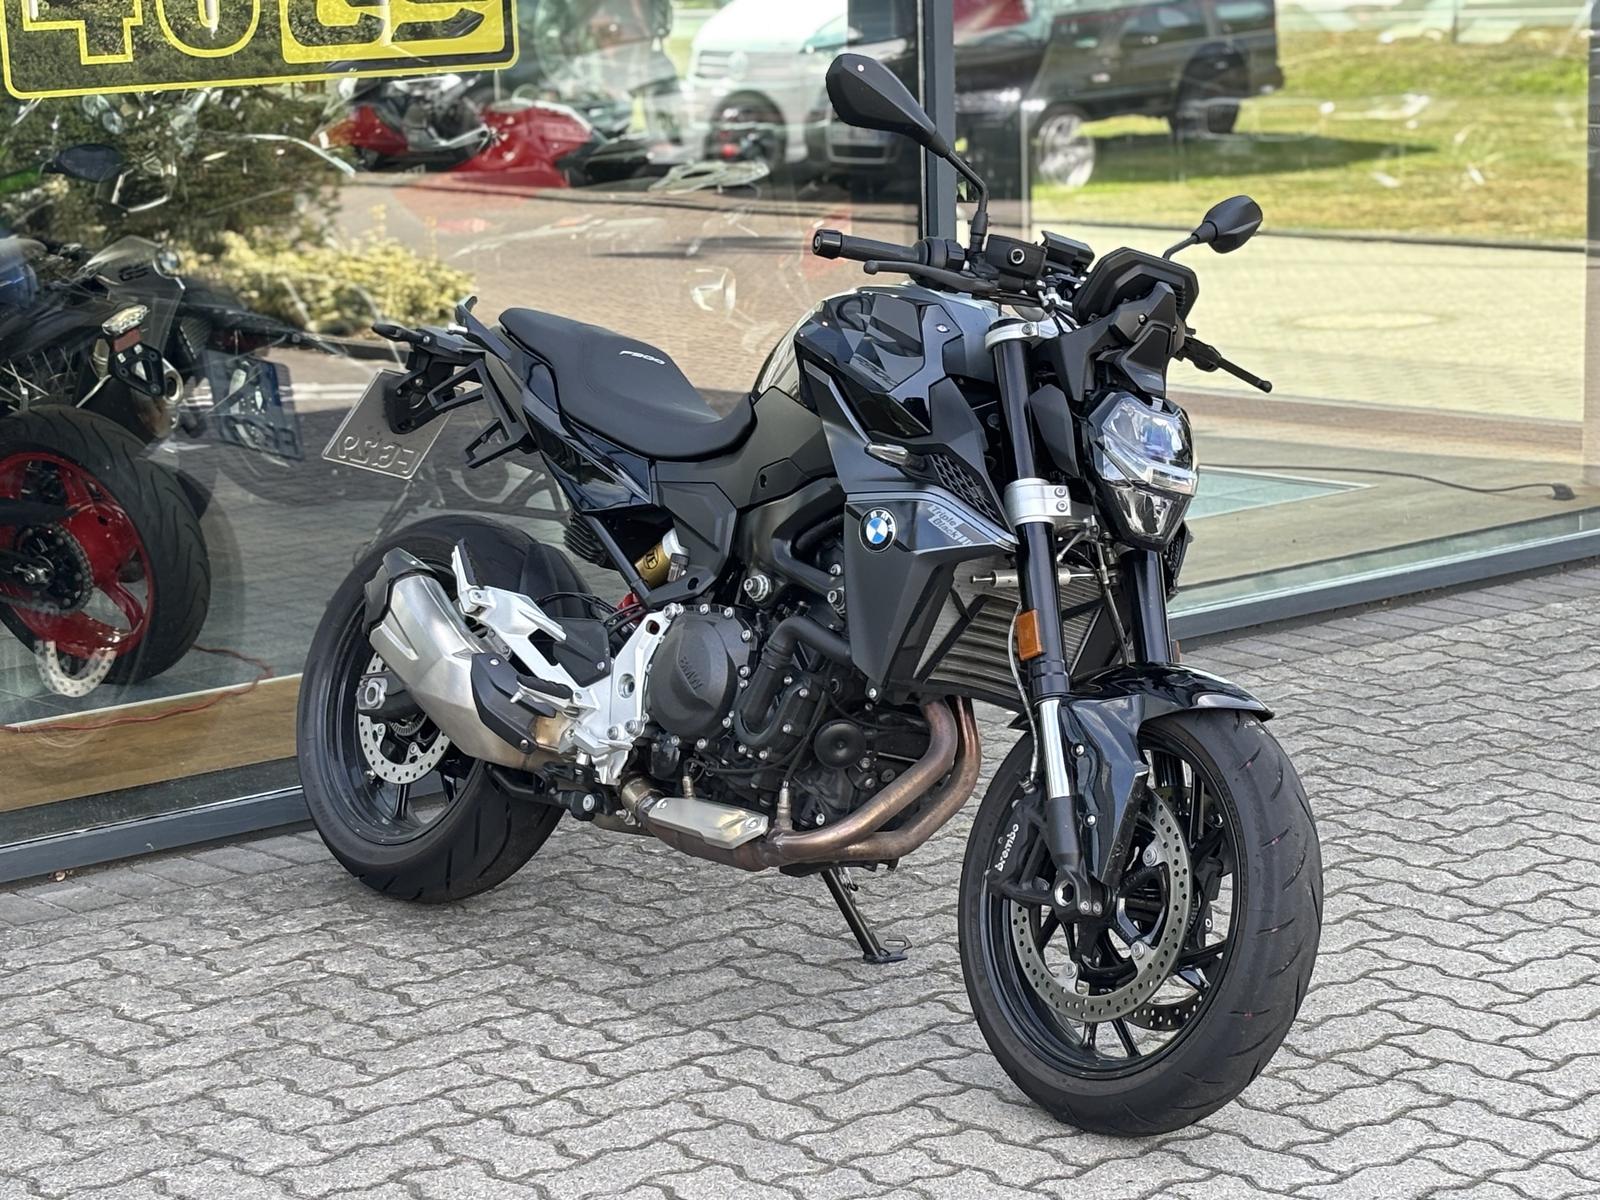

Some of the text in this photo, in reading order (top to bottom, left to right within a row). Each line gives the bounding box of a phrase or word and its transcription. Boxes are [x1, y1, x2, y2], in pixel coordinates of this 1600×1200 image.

[932, 506, 957, 527] Triple
[932, 517, 959, 538] Black
[994, 823, 1019, 872] brembo
